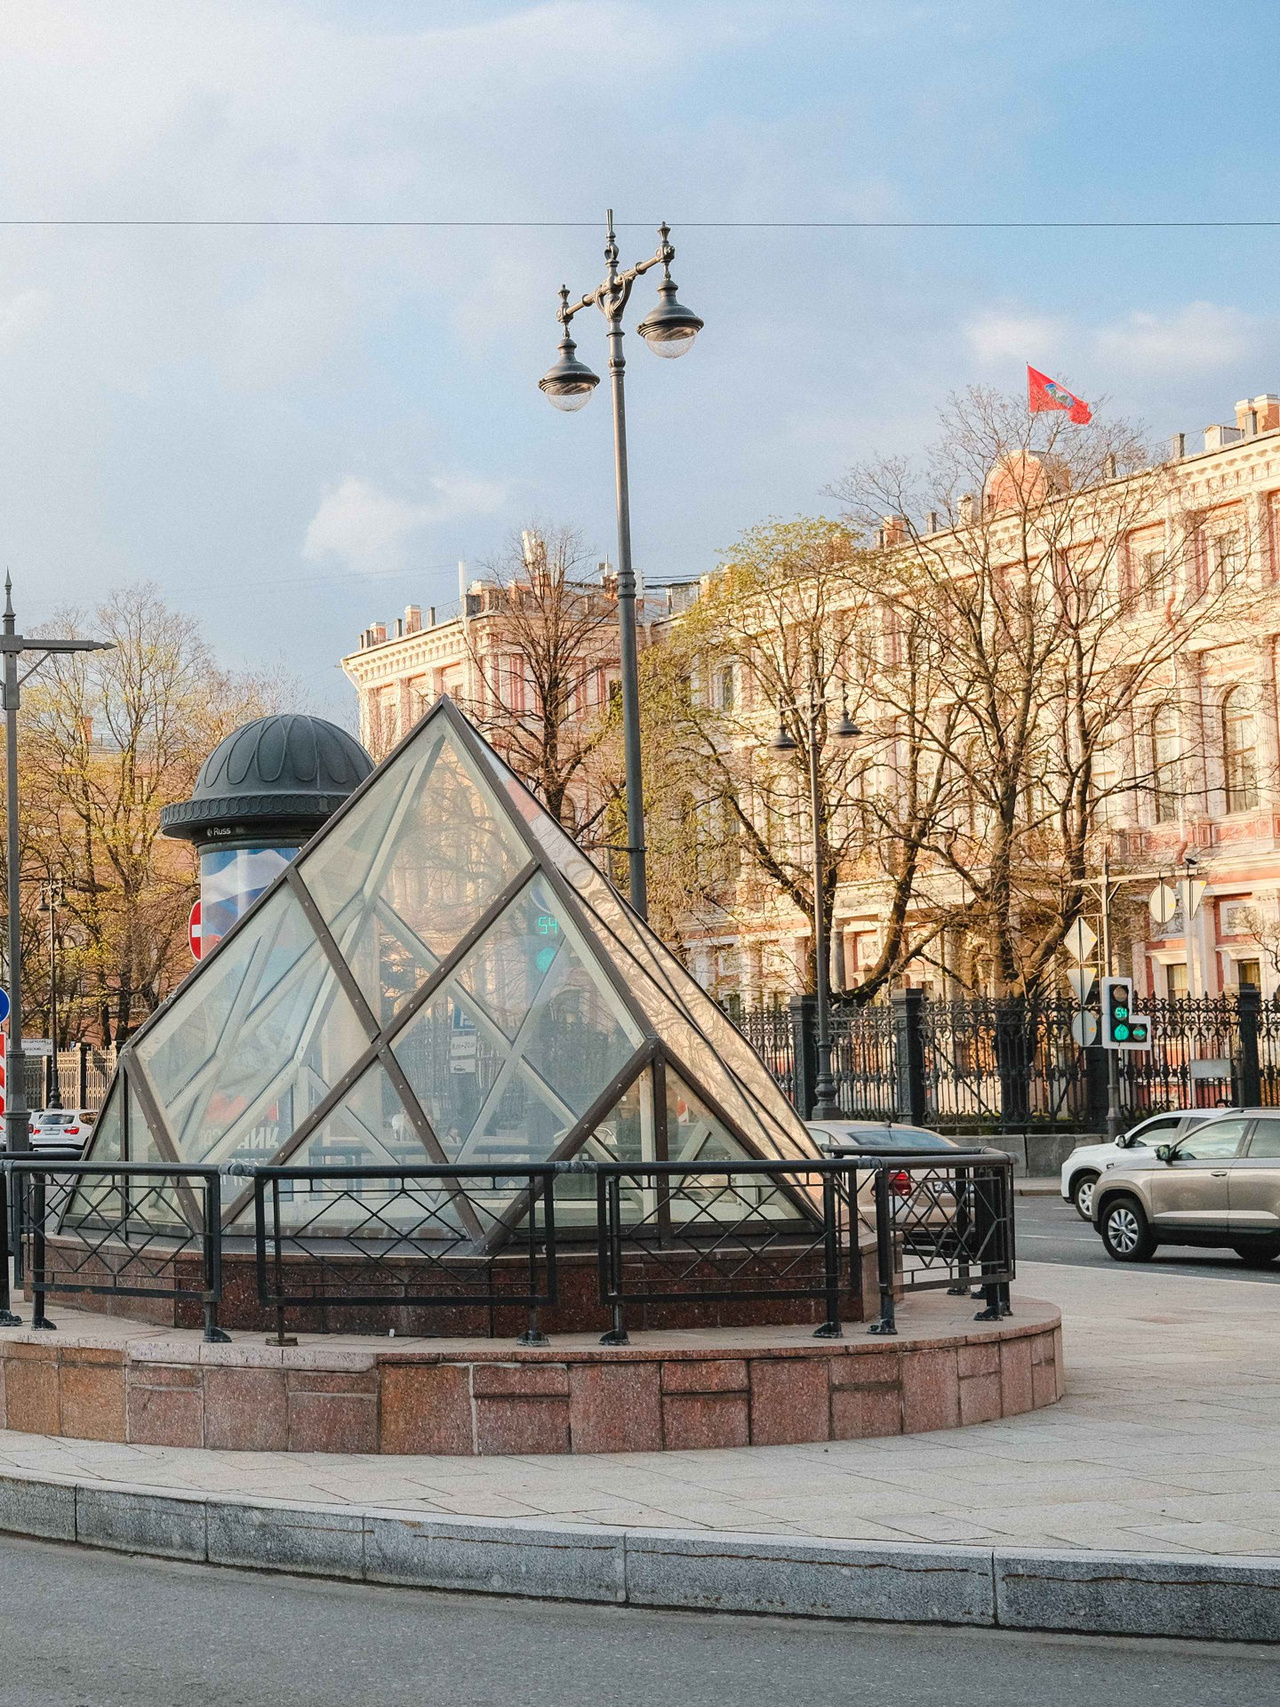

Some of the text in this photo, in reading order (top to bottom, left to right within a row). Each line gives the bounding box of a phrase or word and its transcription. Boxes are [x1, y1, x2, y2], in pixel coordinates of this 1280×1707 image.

[214, 827, 231, 836] Russ
[538, 916, 558, 934] 54
[1115, 1006, 1127, 1018] 54
